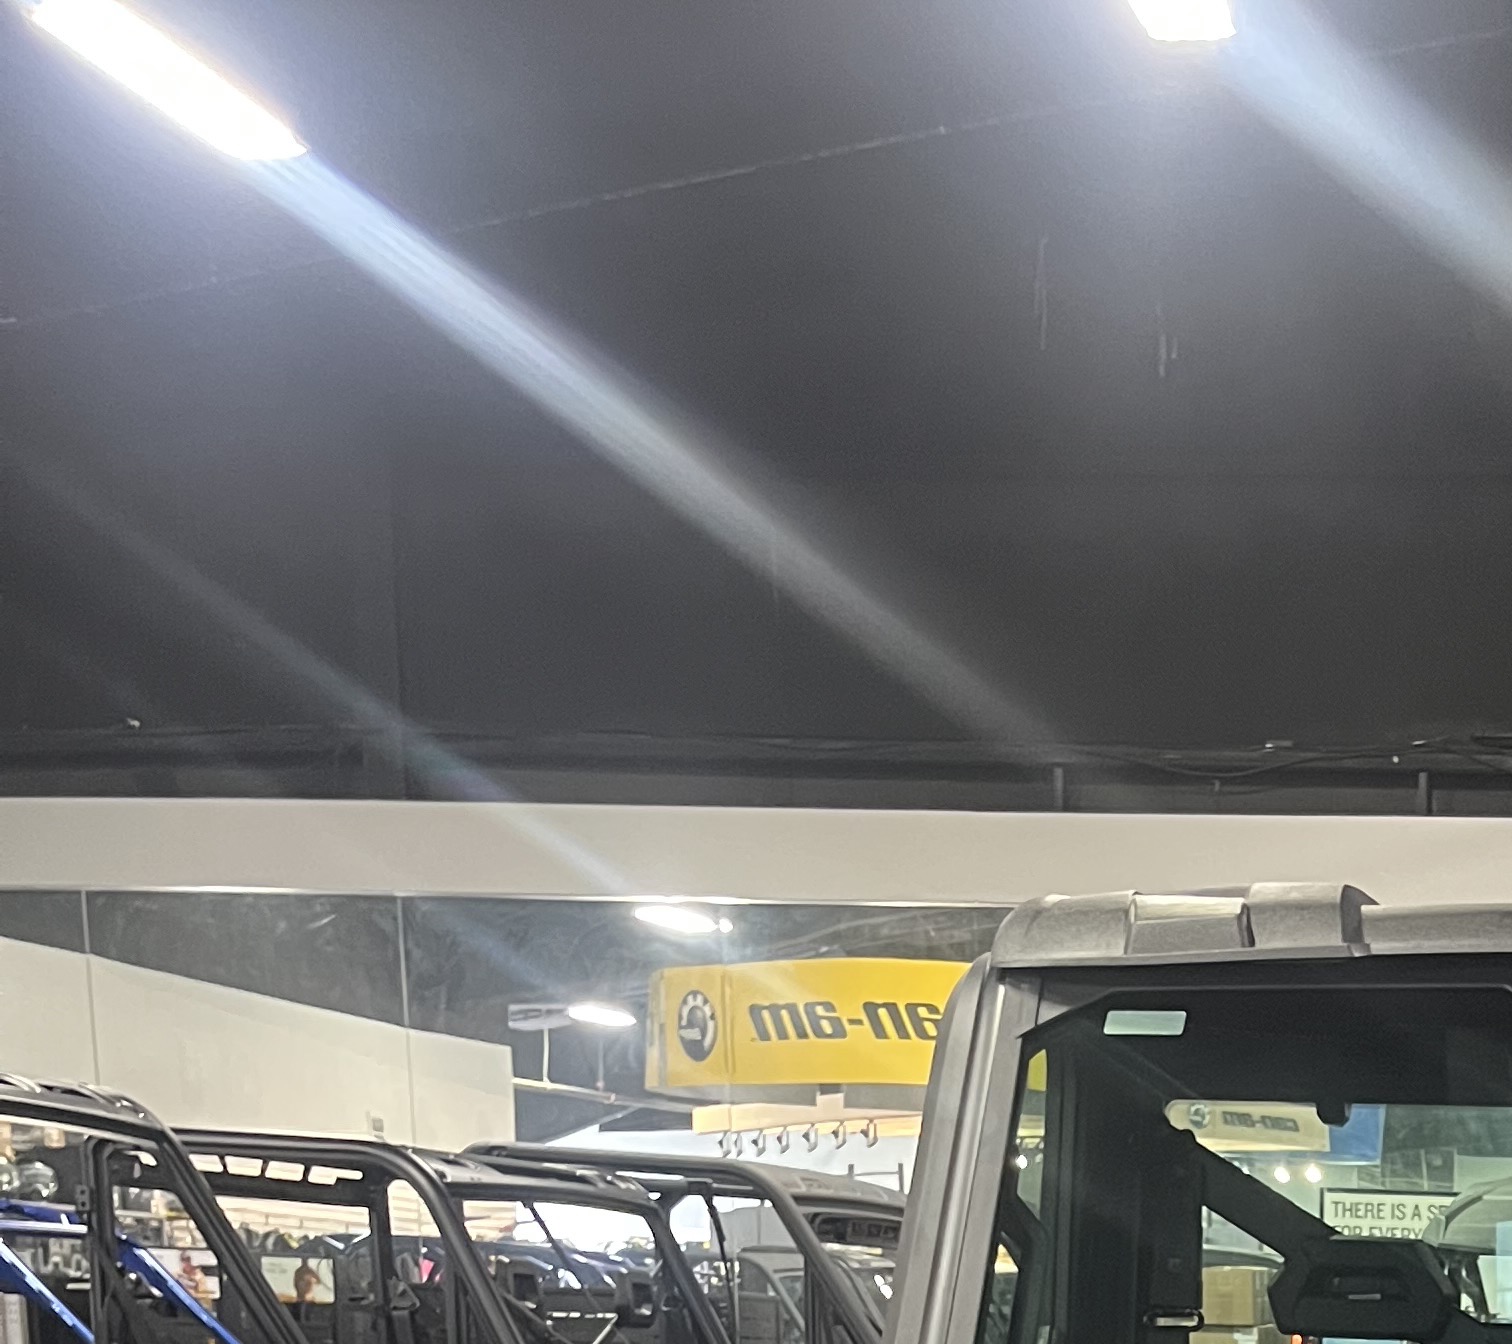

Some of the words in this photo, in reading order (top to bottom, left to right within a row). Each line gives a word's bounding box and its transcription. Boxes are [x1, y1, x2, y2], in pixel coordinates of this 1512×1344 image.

[1331, 1201, 1386, 1220] THERE
[1391, 1203, 1406, 1220] IS
[1411, 1204, 1422, 1221] A
